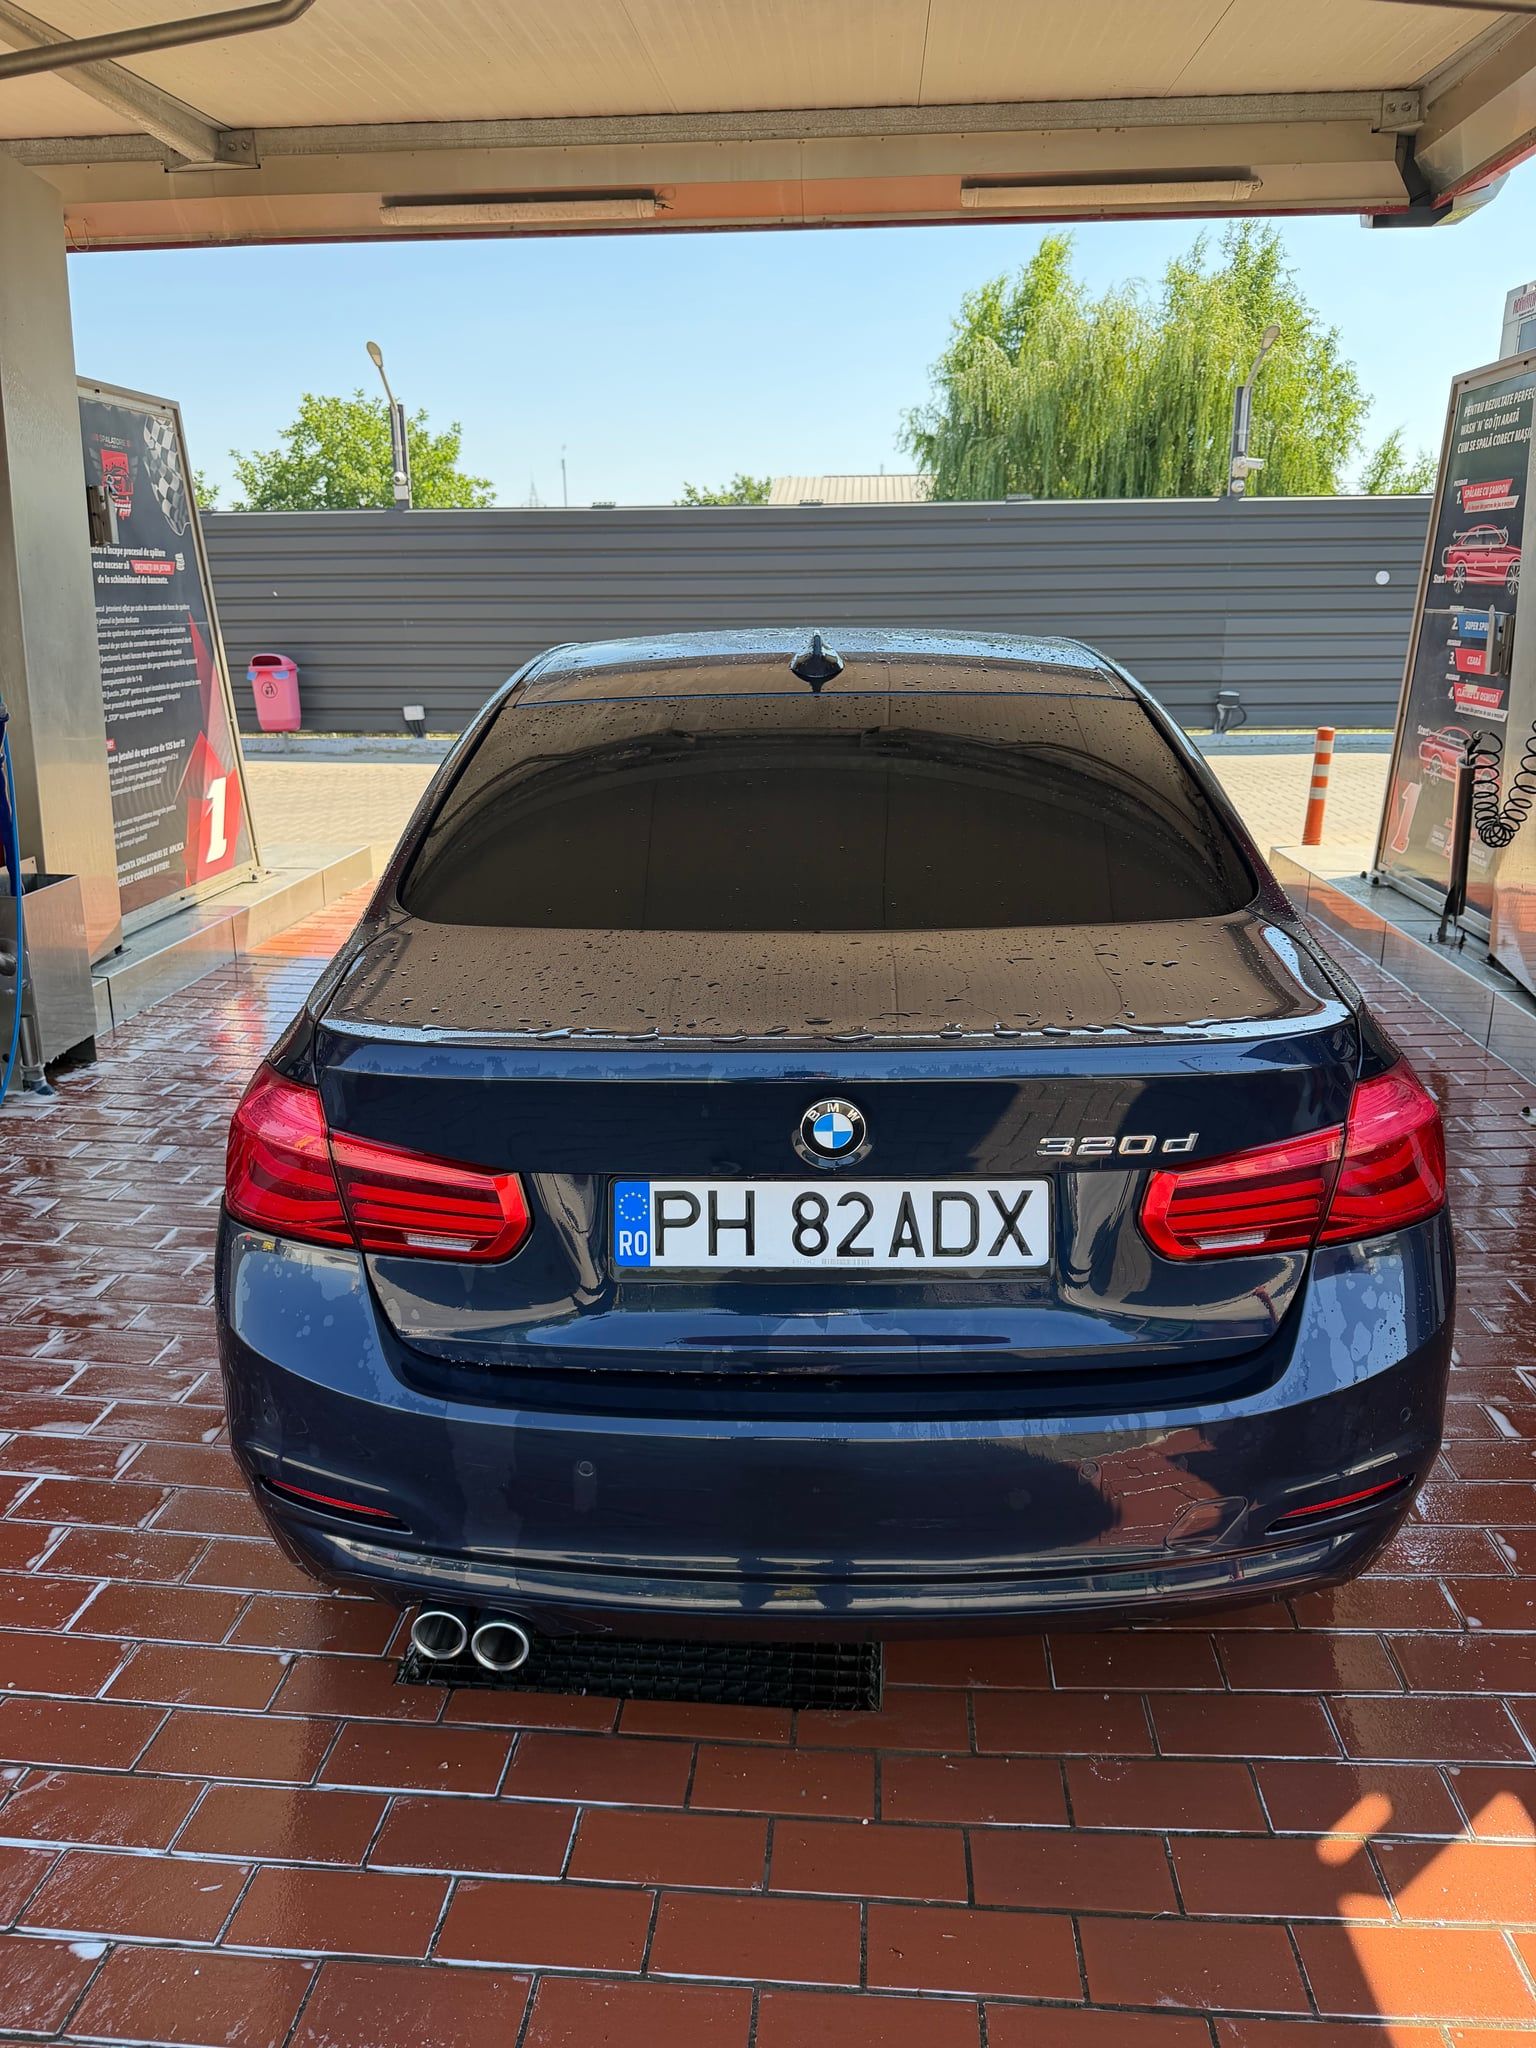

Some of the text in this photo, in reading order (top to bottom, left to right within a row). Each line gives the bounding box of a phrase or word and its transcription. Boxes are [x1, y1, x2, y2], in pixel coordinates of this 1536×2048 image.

[1463, 402, 1485, 417] PENTRU
[1485, 393, 1514, 411] REZULTATE
[1457, 441, 1470, 454] CUM
[1469, 440, 1476, 451] SE
[1493, 430, 1515, 446] CORECT
[93, 560, 104, 569] este
[98, 574, 104, 584] de
[141, 575, 147, 584] de
[205, 776, 227, 864] 1
[807, 1102, 860, 1122] BMW
[1036, 1132, 1199, 1156] 320d
[654, 1190, 1034, 1257] PH 82 ADX
[619, 1230, 648, 1257] RO
